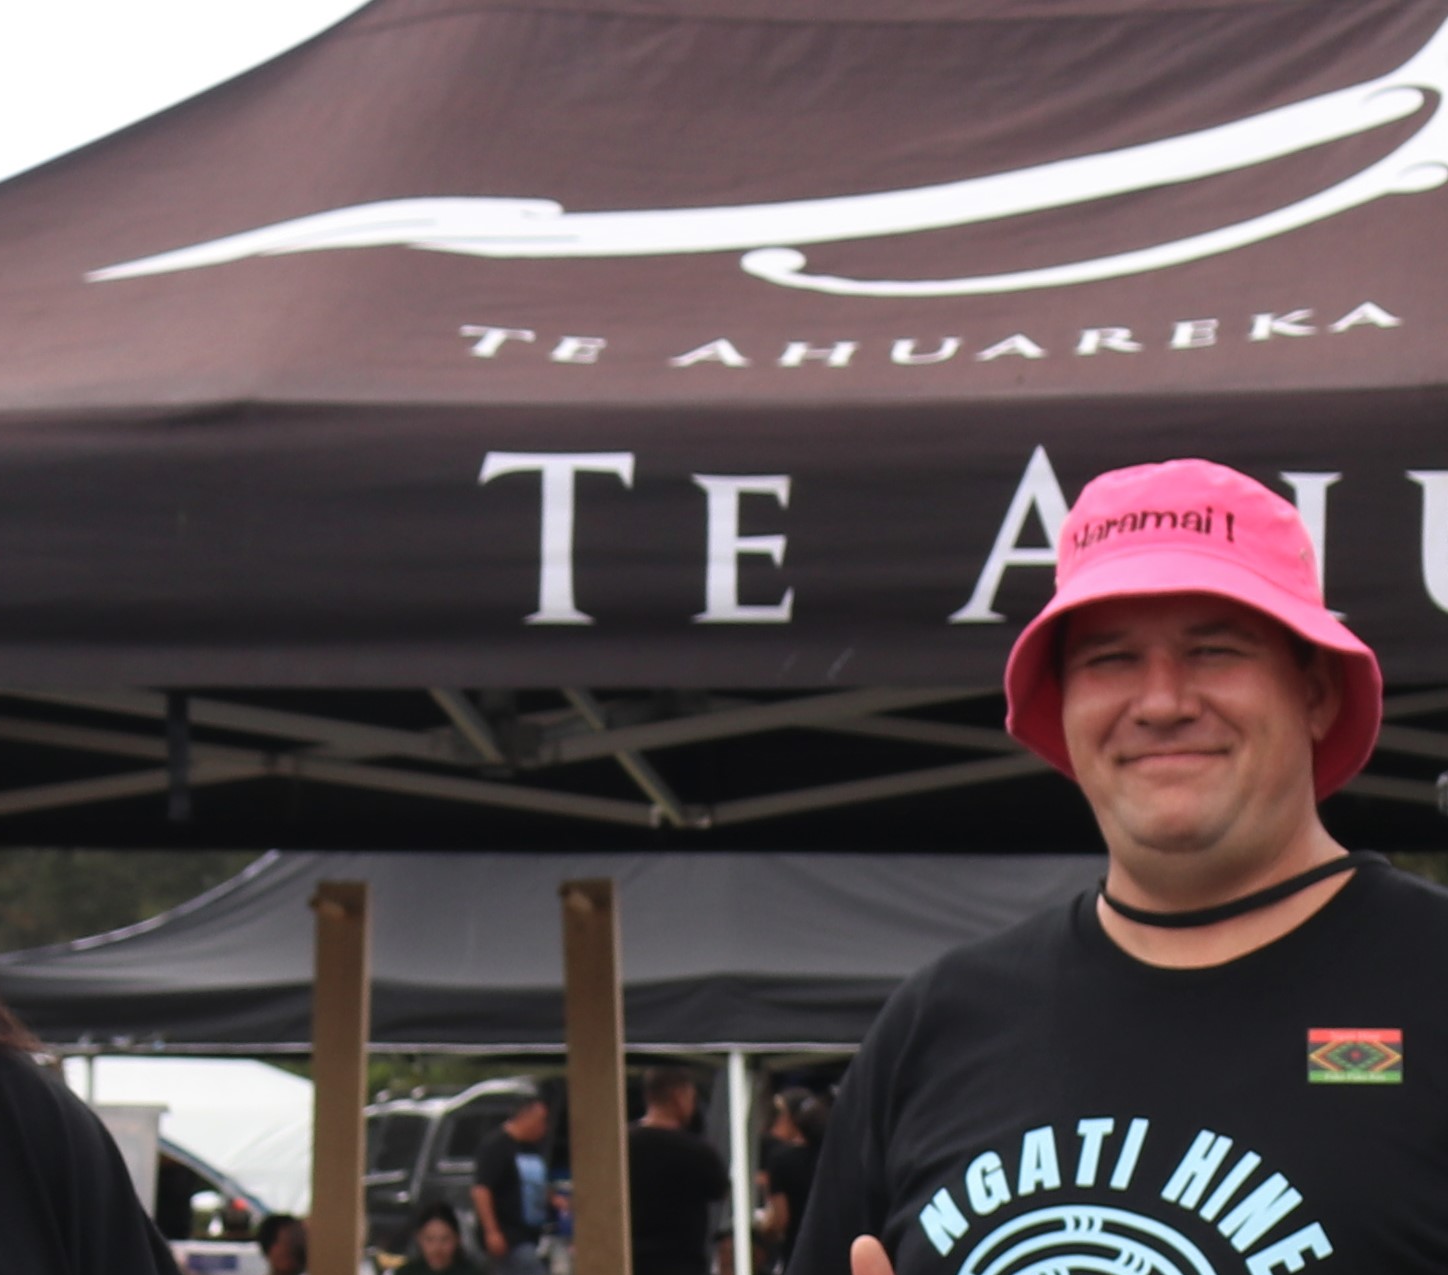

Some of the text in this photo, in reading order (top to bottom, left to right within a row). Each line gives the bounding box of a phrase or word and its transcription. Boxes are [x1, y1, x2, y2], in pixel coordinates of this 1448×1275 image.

[460, 325, 609, 365] TE
[671, 302, 1402, 367] AHUAREKA
[478, 451, 795, 626] TE
[919, 1117, 1150, 1257] NGATI
